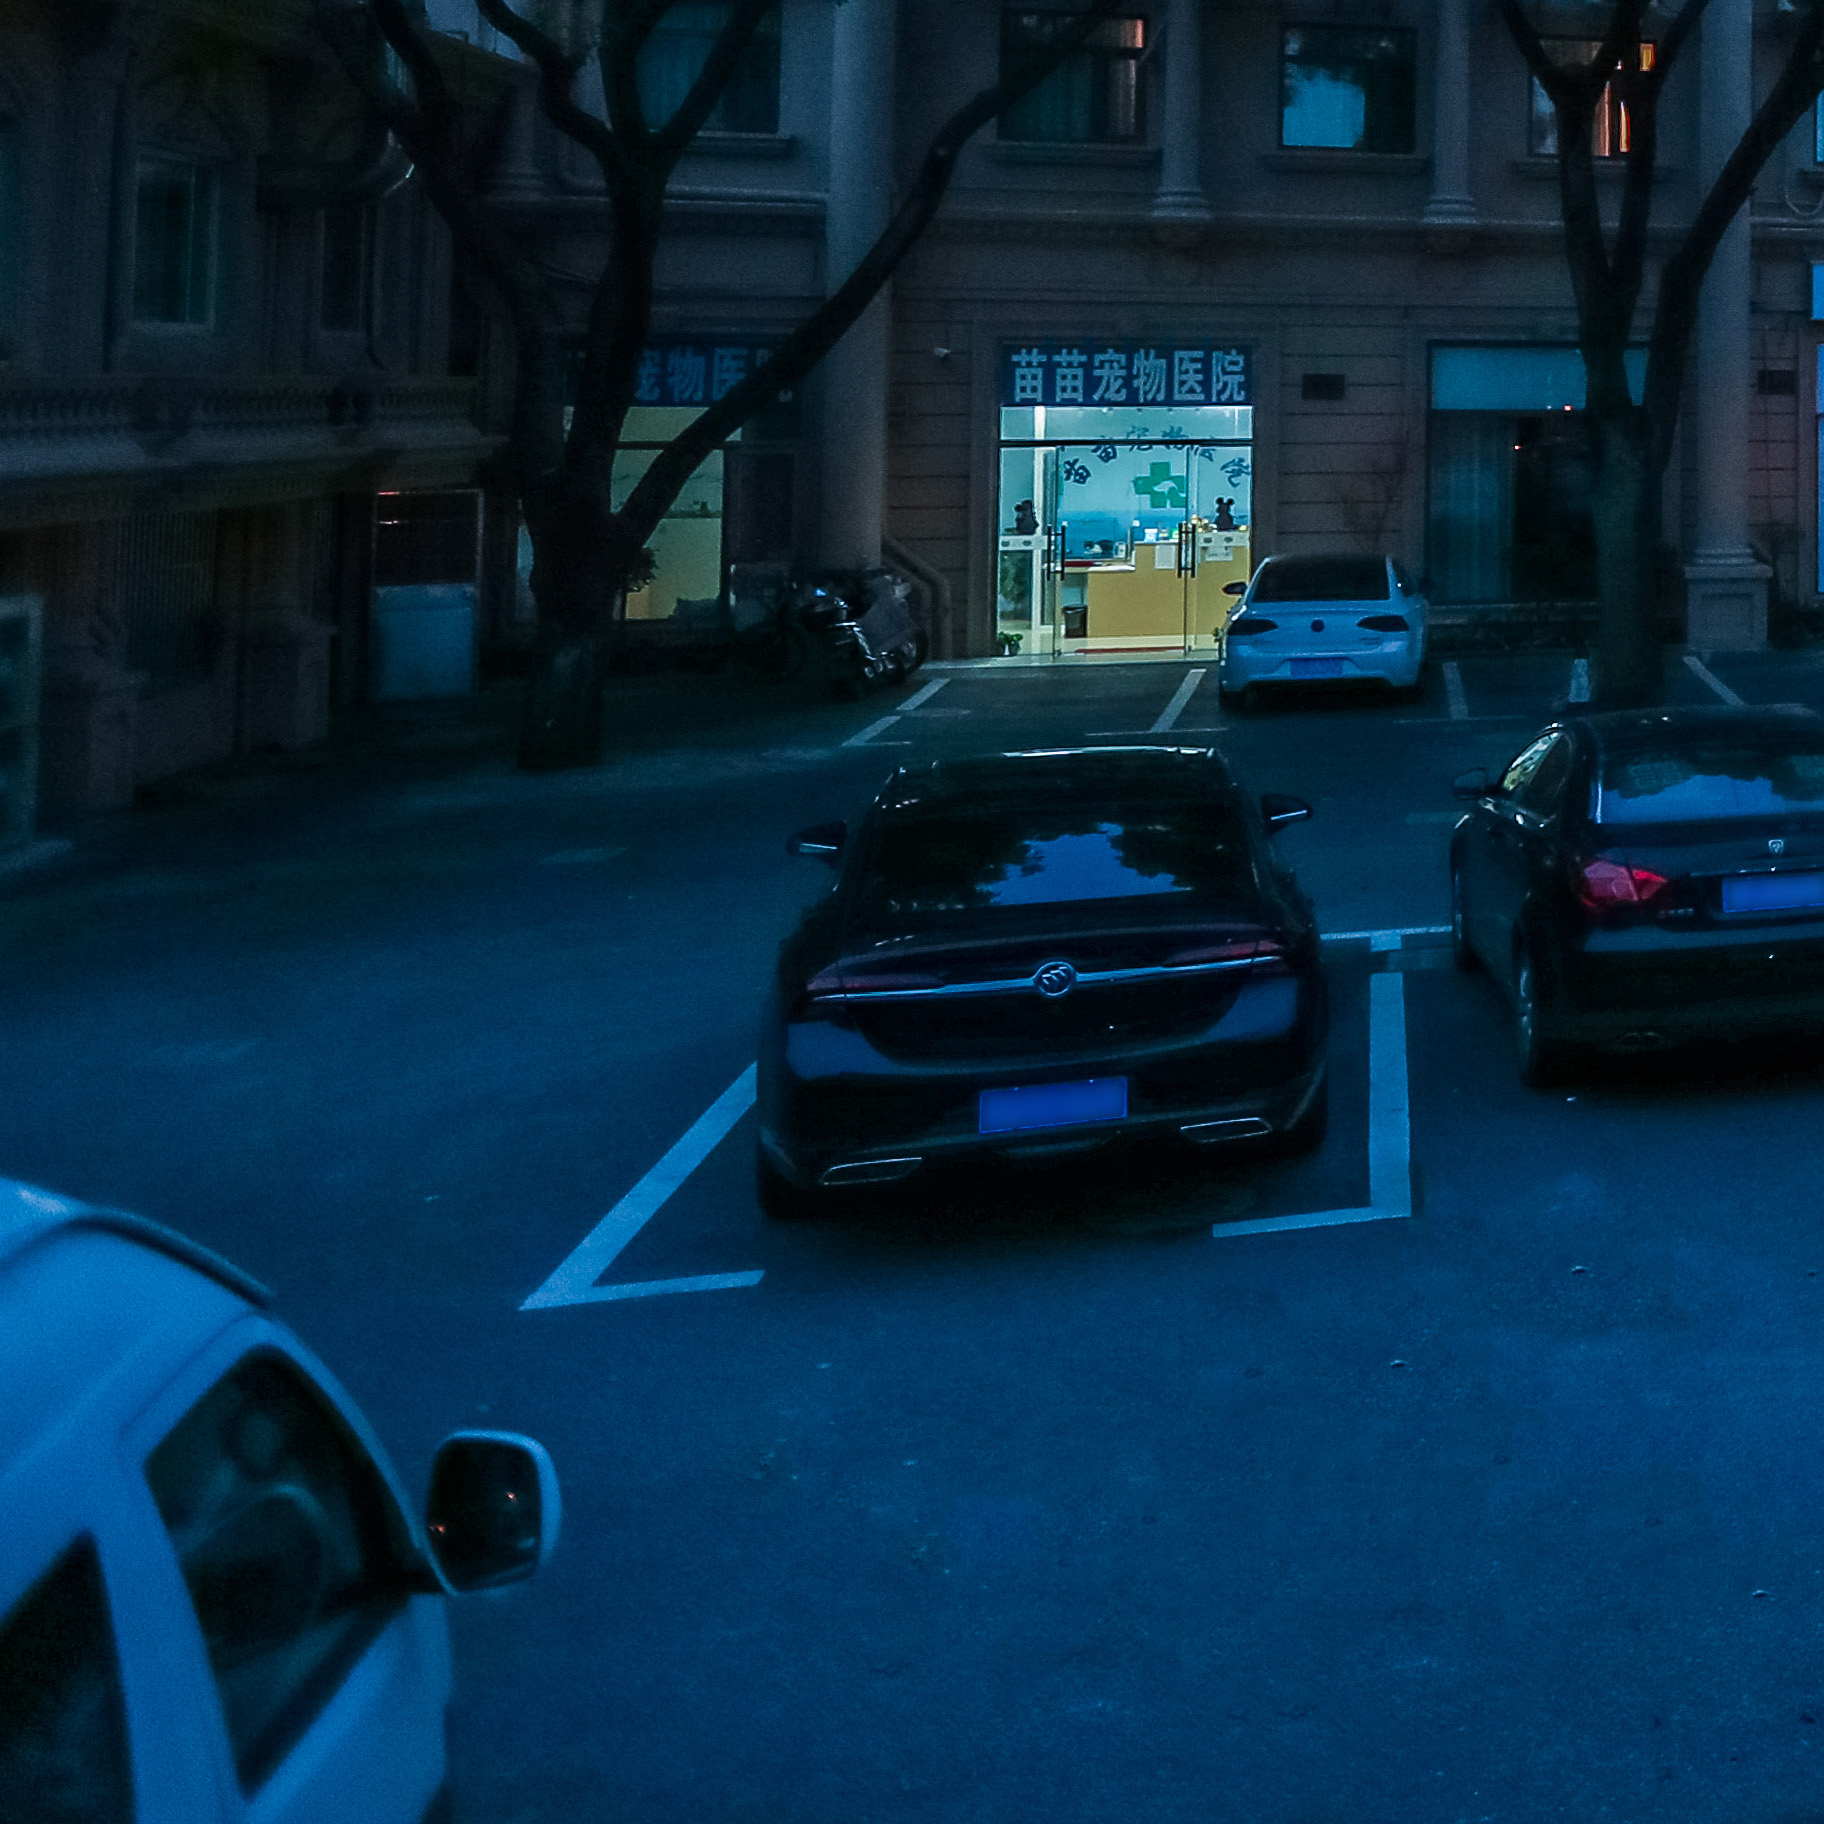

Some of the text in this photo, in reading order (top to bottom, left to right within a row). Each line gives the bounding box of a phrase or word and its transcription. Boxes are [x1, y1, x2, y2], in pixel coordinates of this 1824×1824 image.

[1011, 348, 1246, 403] 苗苗宠物医院
